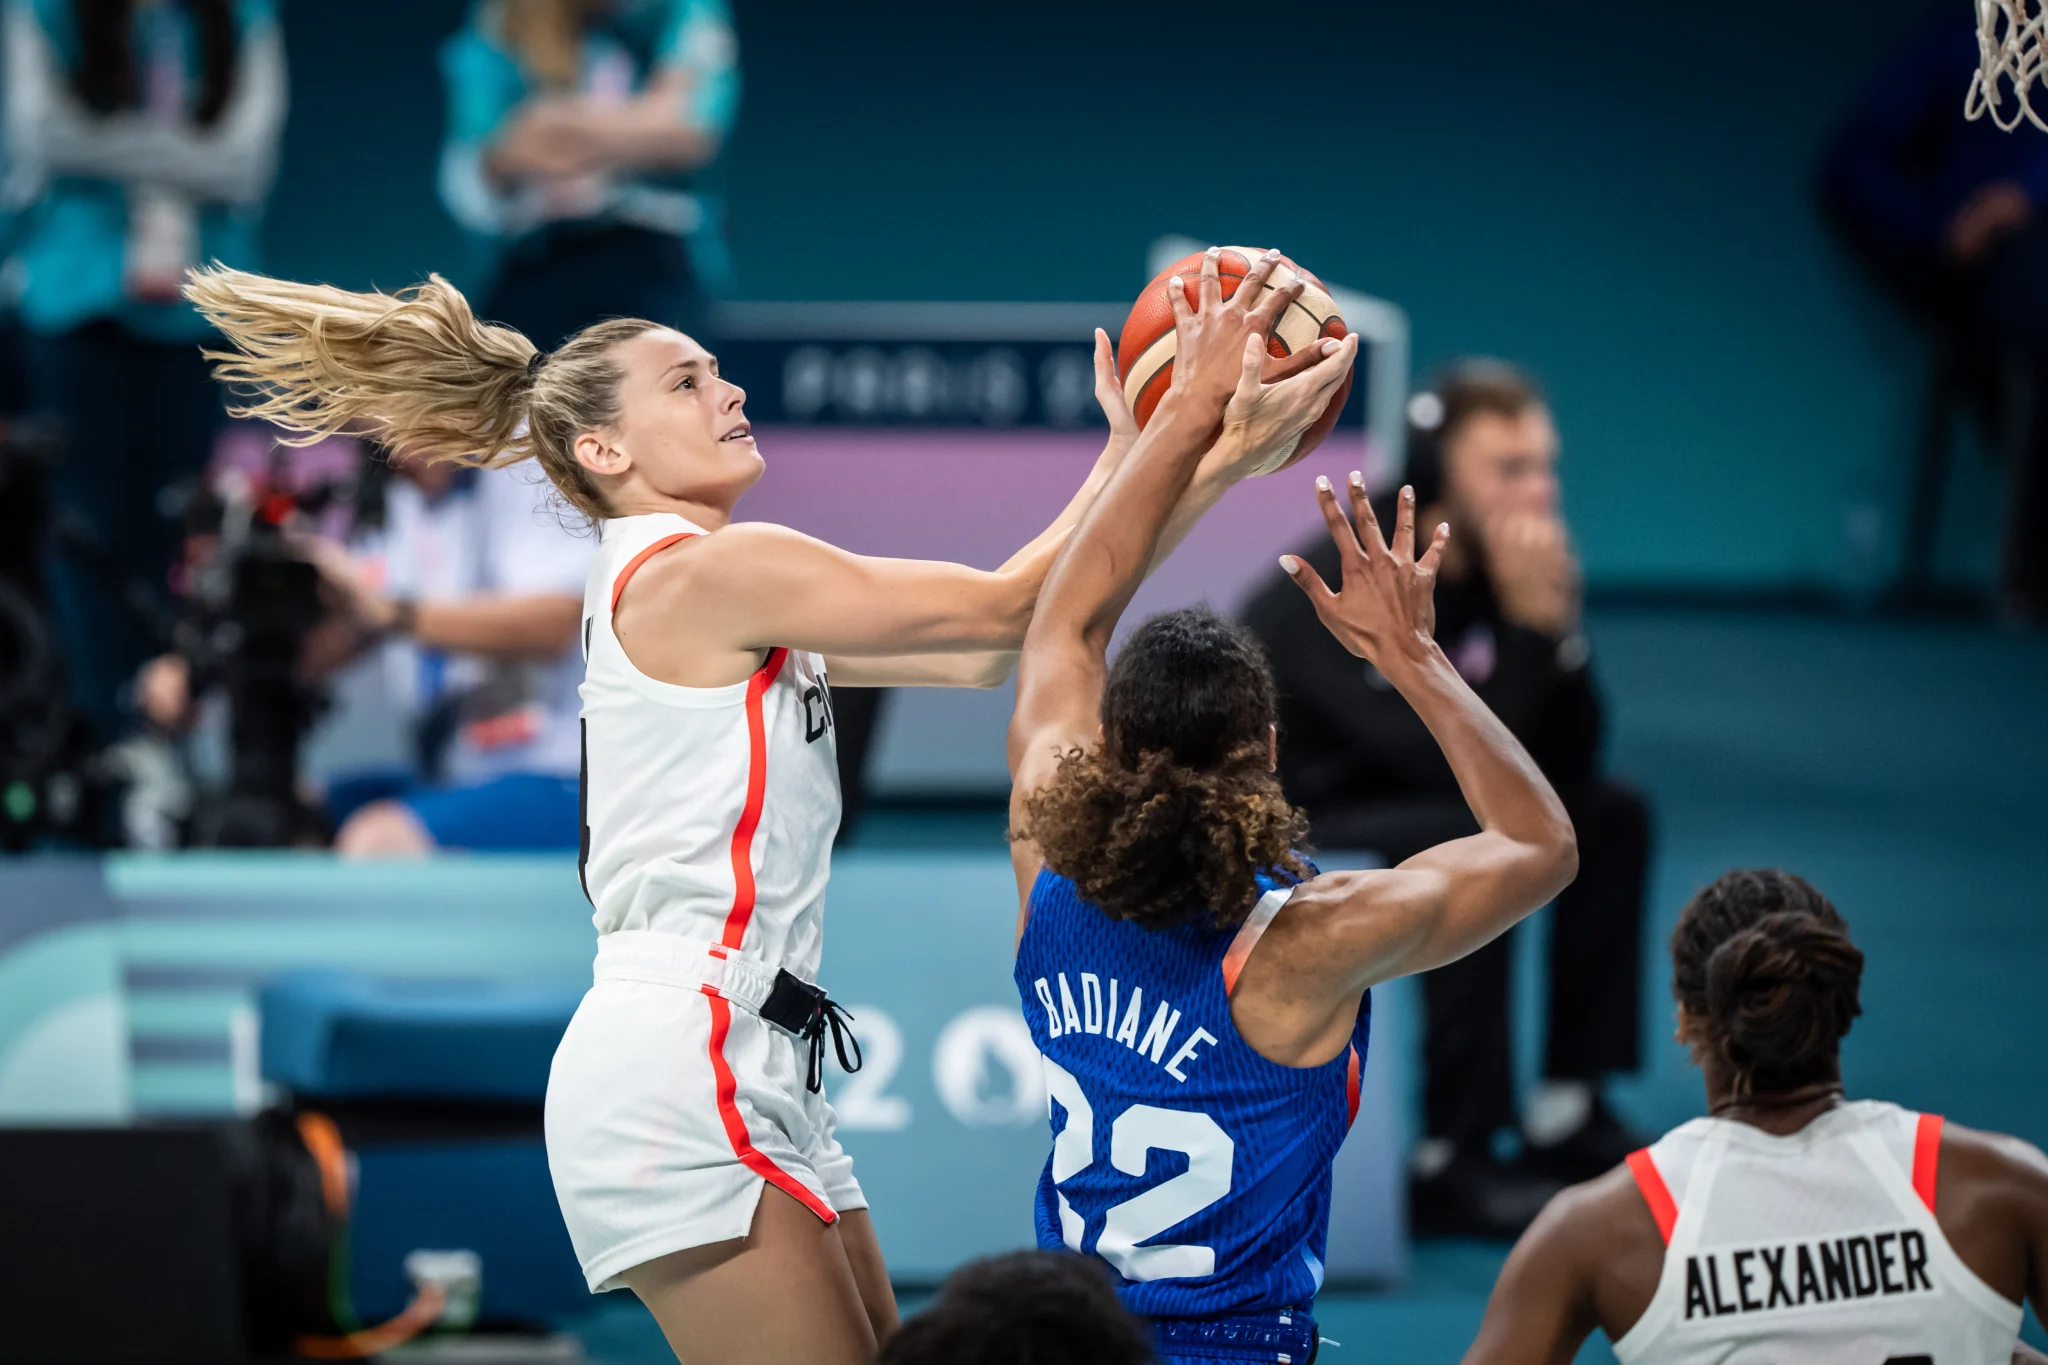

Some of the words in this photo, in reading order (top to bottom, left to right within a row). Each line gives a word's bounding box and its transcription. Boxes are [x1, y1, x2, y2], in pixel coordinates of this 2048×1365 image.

[783, 347, 1028, 420] PARIS
[1034, 972, 1218, 1083] BADIANE
[1684, 1228, 1934, 1321] ALEXANDER
